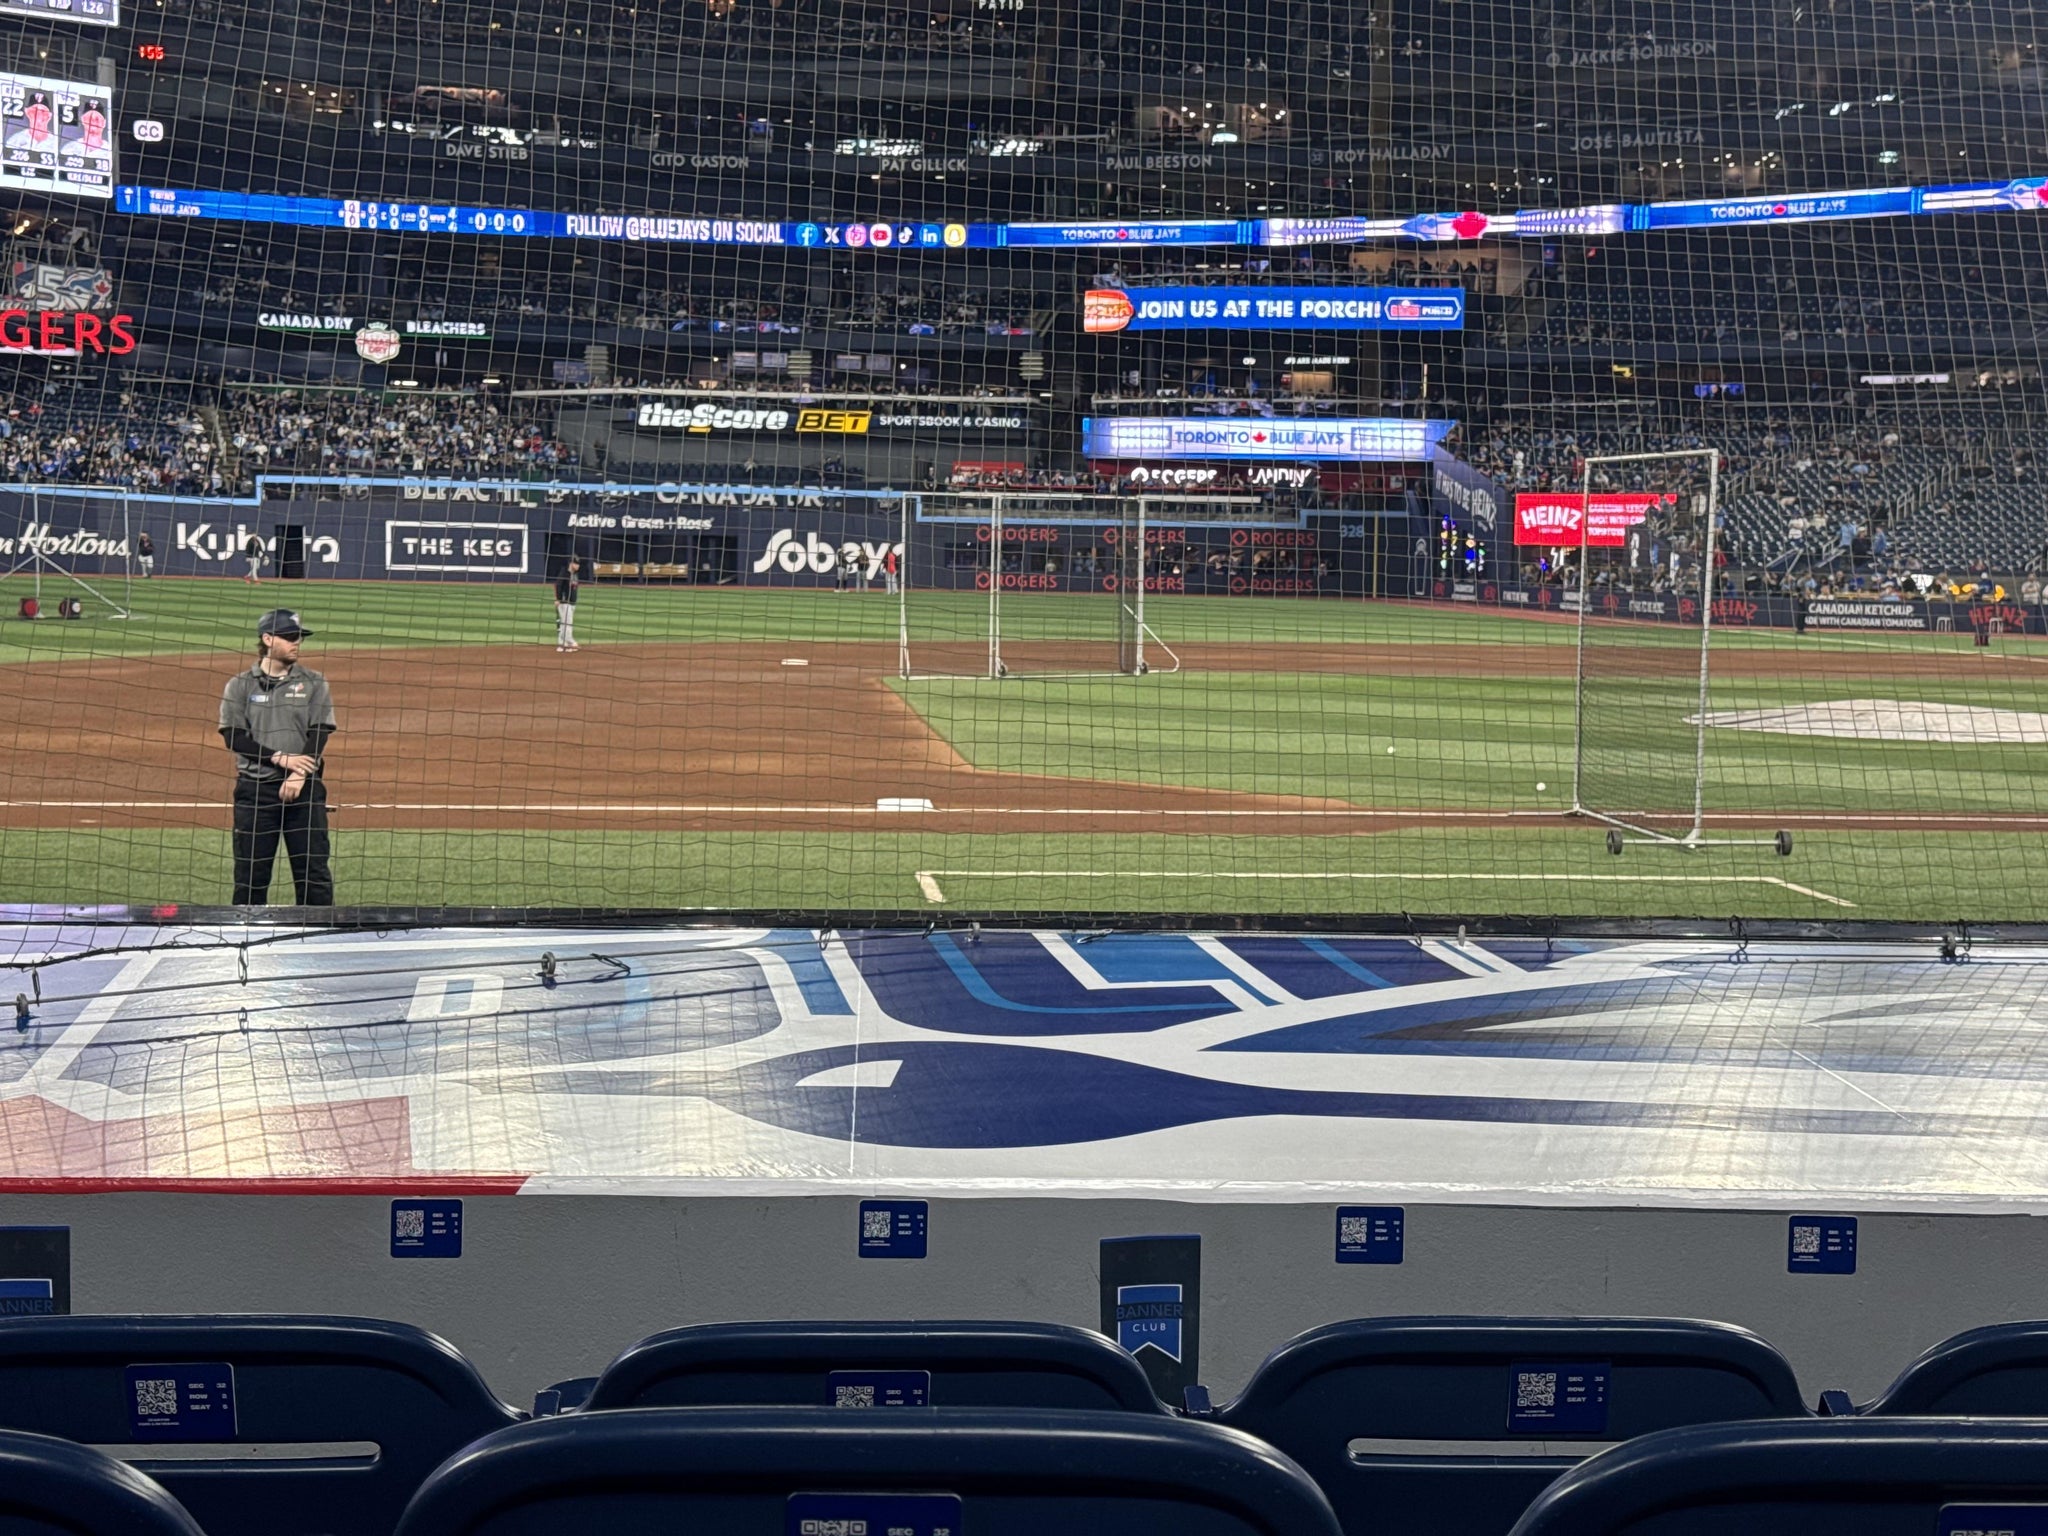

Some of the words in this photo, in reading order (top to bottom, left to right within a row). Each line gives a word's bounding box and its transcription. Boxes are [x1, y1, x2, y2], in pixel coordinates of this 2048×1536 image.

[1570, 49, 1624, 66] JACKIE
[1630, 42, 1715, 59] ROBINSON
[62, 106, 74, 123] 5
[137, 125, 160, 138] CC
[1622, 130, 1705, 148] BAUTISTA
[446, 144, 483, 158] DAVE
[489, 146, 529, 160] STIEB
[1334, 149, 1366, 163] ROY
[1371, 144, 1451, 161] HALLADAY
[652, 153, 685, 167] CITO
[690, 154, 749, 169] GASTON
[881, 159, 910, 172] PAT
[911, 158, 967, 172] GILLICK
[1106, 157, 1142, 170] PAUL
[1146, 155, 1212, 169] BEESTON
[1710, 204, 1772, 218] TORONTO
[1787, 201, 1816, 214] BLUE
[1817, 199, 1847, 213] JAYS
[566, 215, 623, 237] FOLLOW
[626, 215, 710, 241] @BLUEJAYS
[712, 218, 733, 241] ON
[735, 219, 785, 244] SOCIAL
[1061, 229, 1117, 240] TORONTO
[1128, 229, 1154, 240] BLUE
[1155, 228, 1181, 239] JAYS
[1138, 301, 1184, 318] JOIN
[1190, 300, 1218, 317] US
[1222, 300, 1250, 317] AT
[1256, 300, 1294, 317] THE
[1301, 300, 1381, 318] PORCH!
[258, 313, 322, 328] CANADA
[324, 316, 354, 331] DRY
[406, 321, 486, 335] BLEACHERS
[638, 402, 789, 430] theScore
[800, 412, 870, 430] BET
[879, 416, 960, 427] SPORTSBOOK
[963, 416, 971, 427] &
[975, 417, 1021, 428] CASINO
[1175, 431, 1249, 444] TORONTO
[1269, 431, 1305, 445] BLUE
[1307, 432, 1344, 446] JAYS
[1471, 488, 1497, 530] HEINZ
[568, 513, 617, 528] Active
[1520, 506, 1582, 531] HEINZ
[11, 521, 129, 556] Hortons
[1341, 524, 1364, 538] 328
[402, 537, 453, 555] THE
[463, 539, 512, 557] KEG
[1253, 532, 1315, 547] ROGERS
[1252, 579, 1314, 592] ROGERS
[1808, 602, 1863, 615] CANADIAN
[1820, 616, 1840, 626] WITH
[1841, 617, 1881, 628] CANADIAN
[1116, 1303, 1183, 1320] BANNER
[1132, 1323, 1167, 1333] CLUB
[888, 1528, 914, 1536] SEC
[933, 1528, 950, 1536] 32
